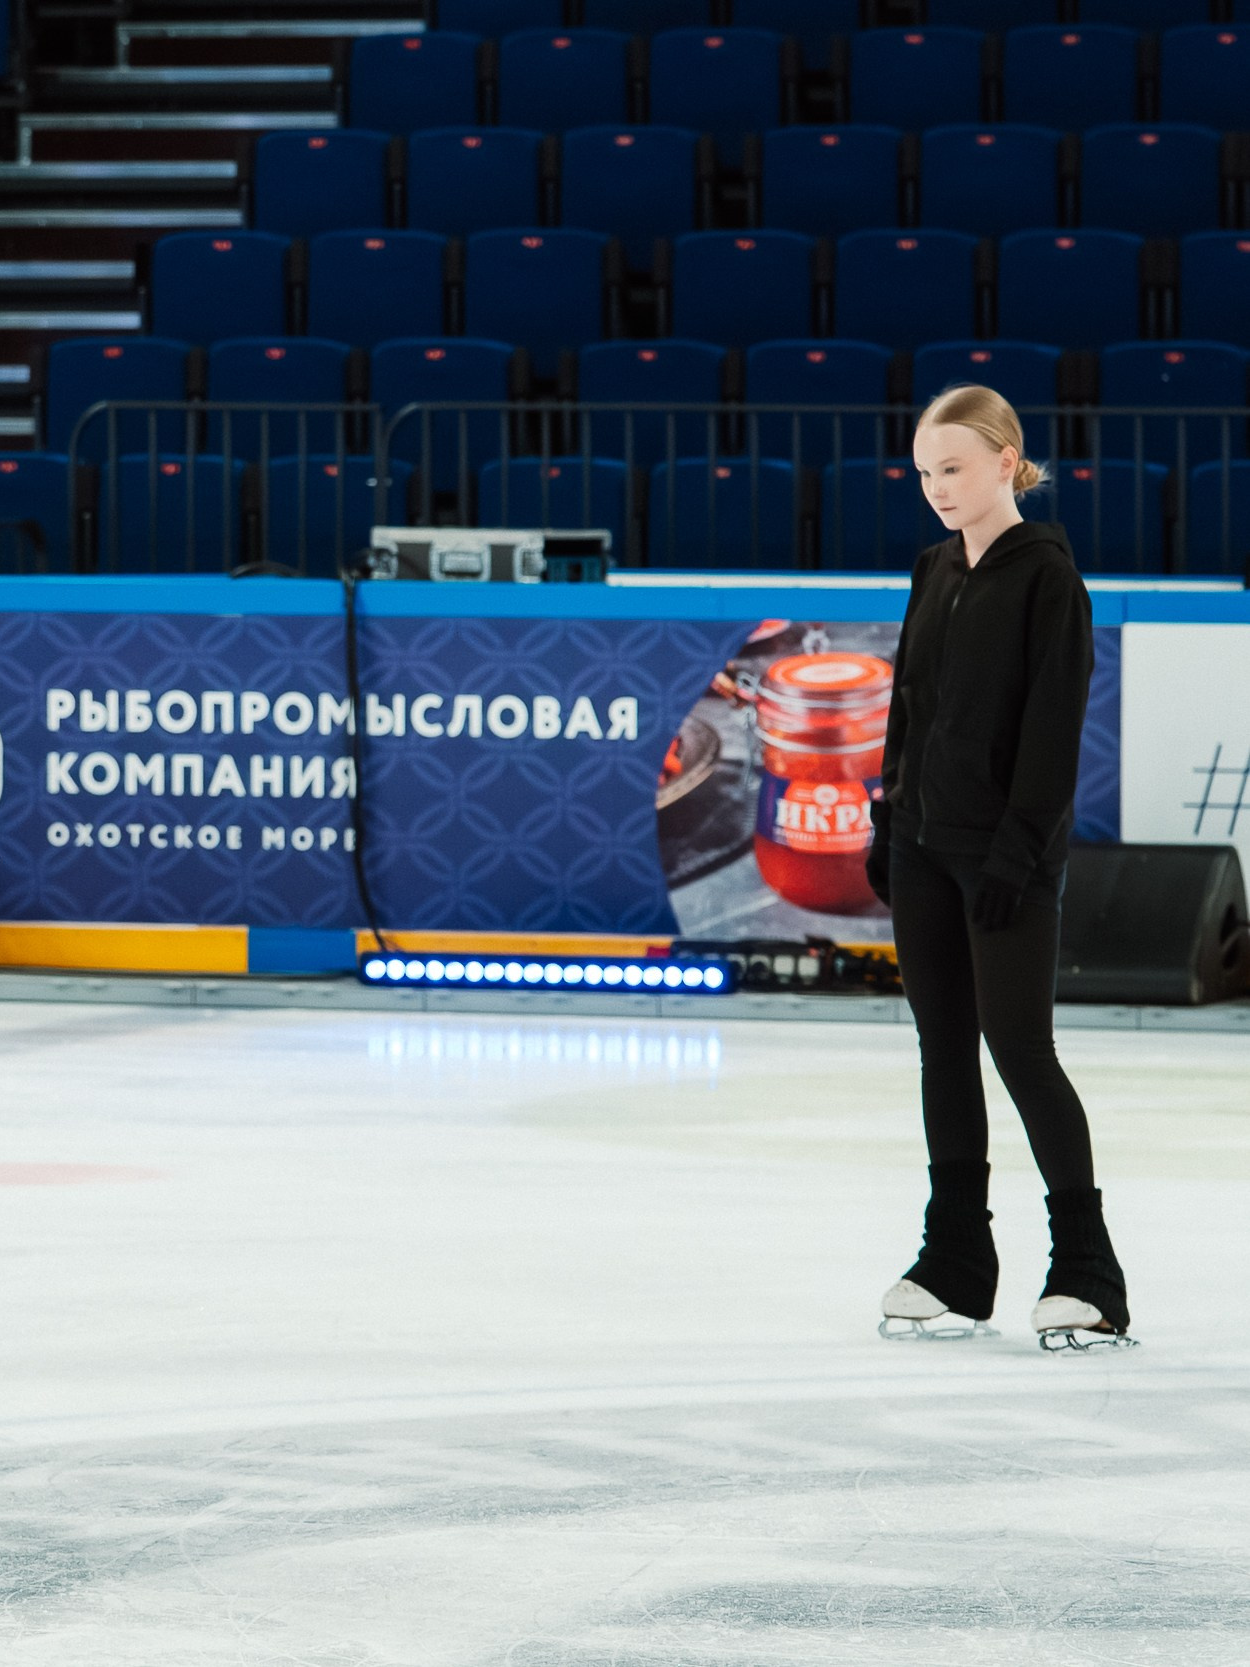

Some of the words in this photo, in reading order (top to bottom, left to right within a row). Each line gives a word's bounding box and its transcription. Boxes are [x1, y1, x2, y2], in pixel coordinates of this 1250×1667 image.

[46, 687, 639, 741] РЫБОПРОМЫСЛОВАЯ
[46, 751, 357, 799] КОМПАНИЯ
[47, 821, 243, 850] ОХОТСКОЕ
